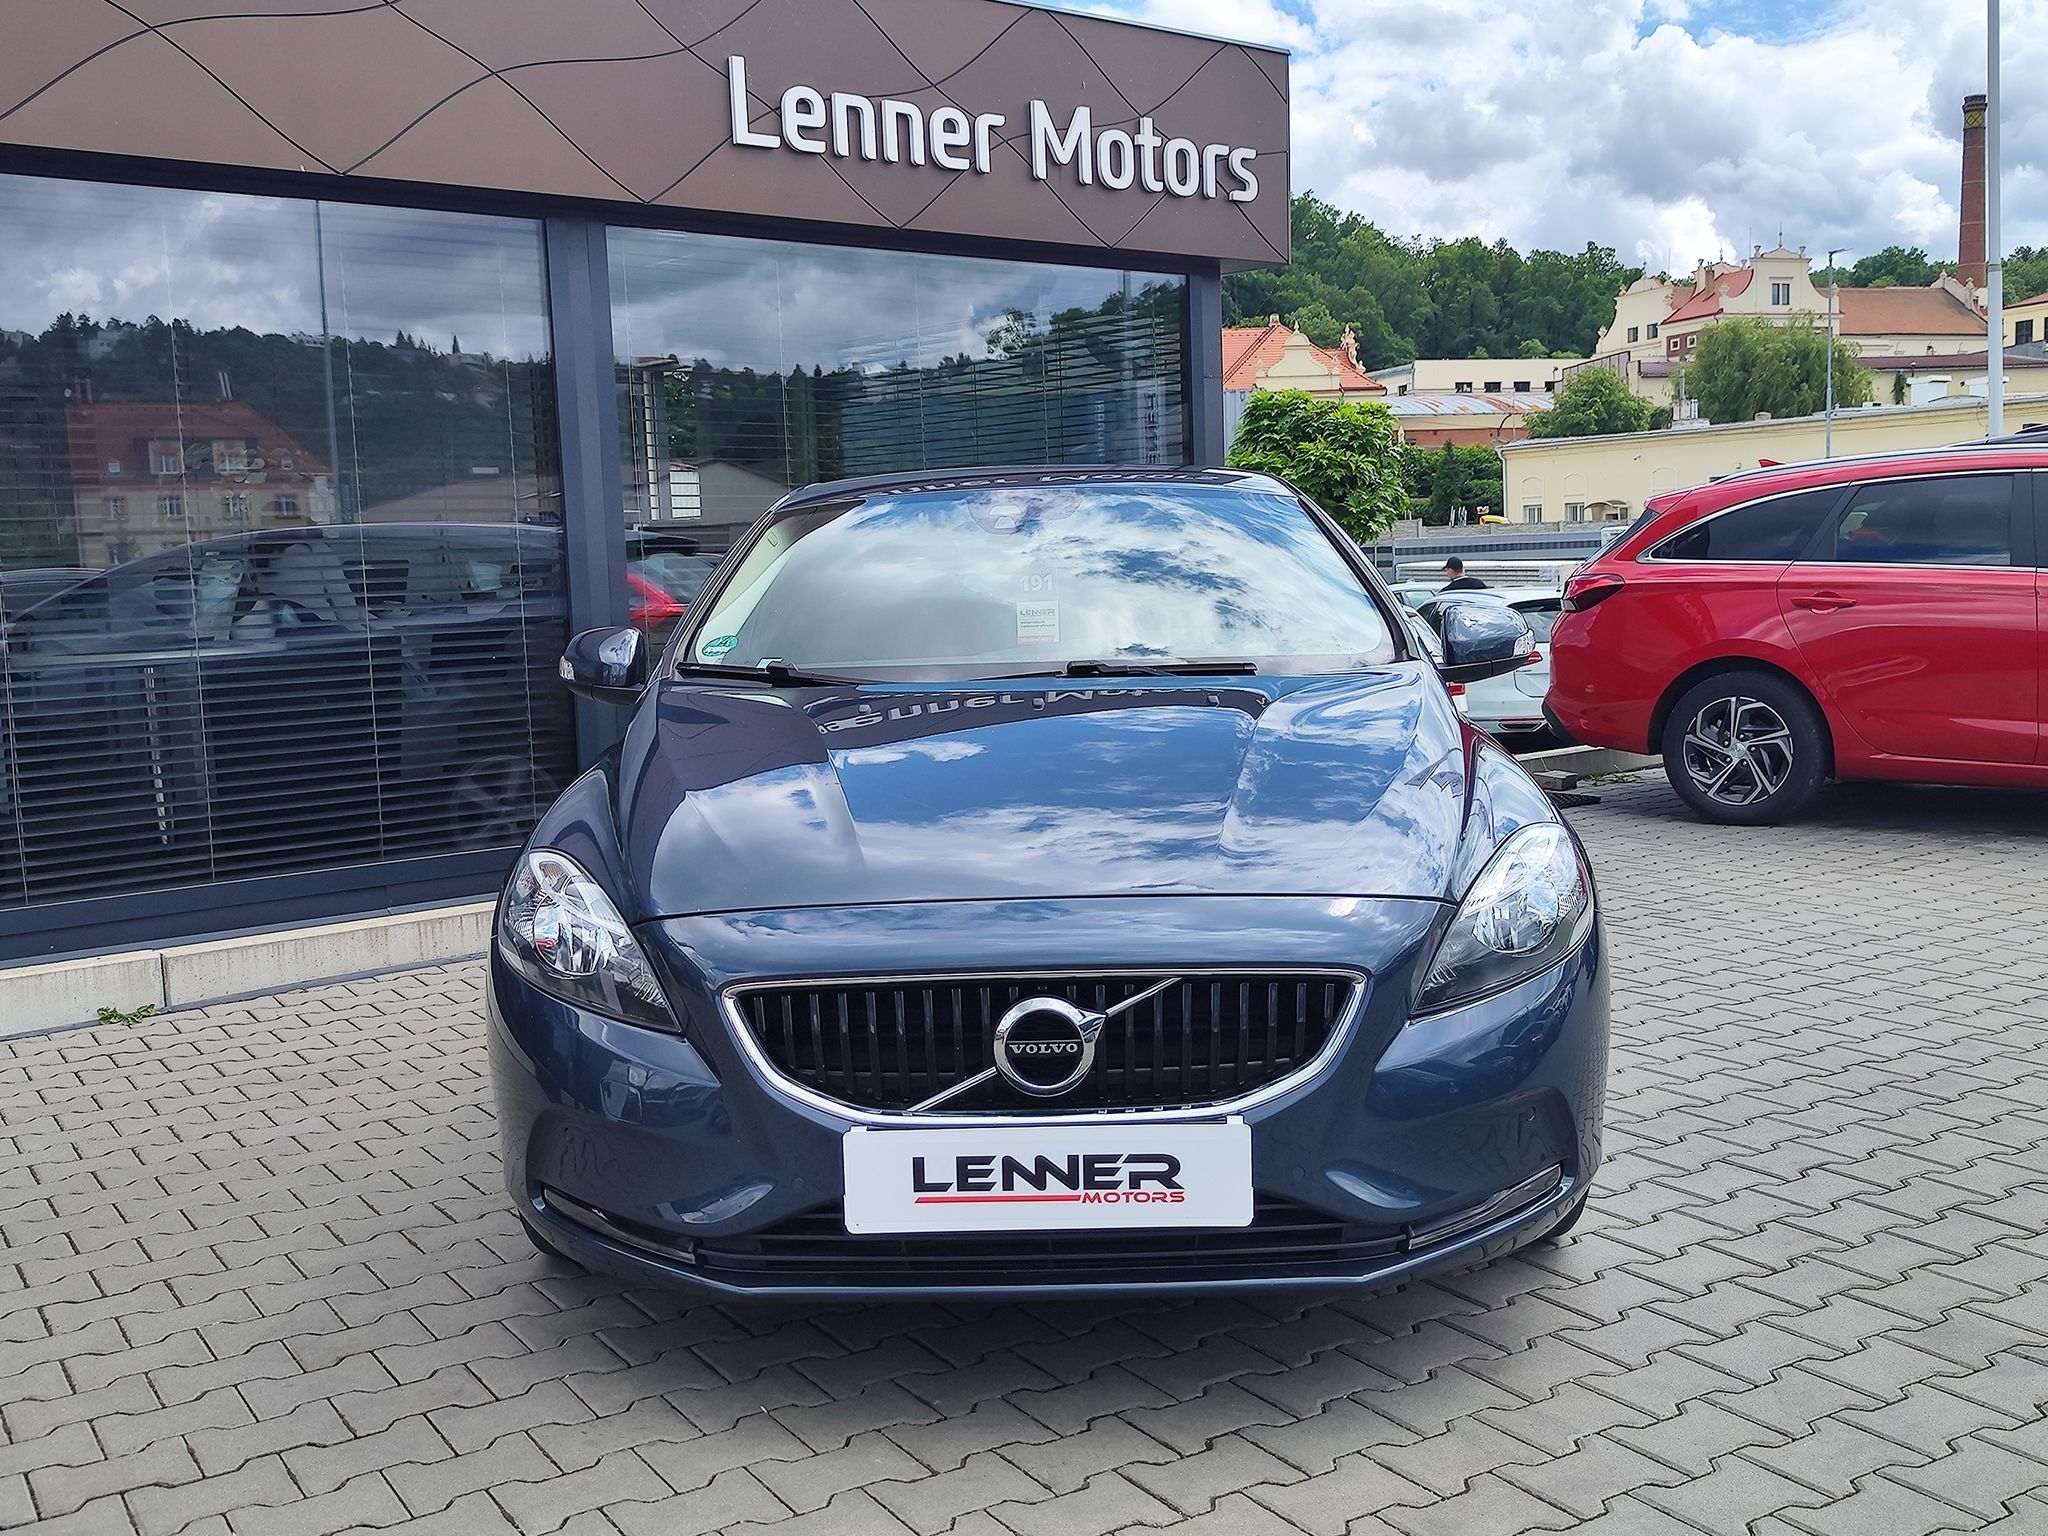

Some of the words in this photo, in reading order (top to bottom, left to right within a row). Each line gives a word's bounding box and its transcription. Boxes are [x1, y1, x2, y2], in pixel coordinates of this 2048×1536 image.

[728, 54, 1005, 174] Lenner
[1029, 98, 1259, 202] Motors
[1020, 574, 1054, 592] 191
[1008, 1042, 1079, 1054] VOLVO
[912, 1153, 1185, 1193] LENNER
[1081, 1191, 1185, 1204] MOTORS
